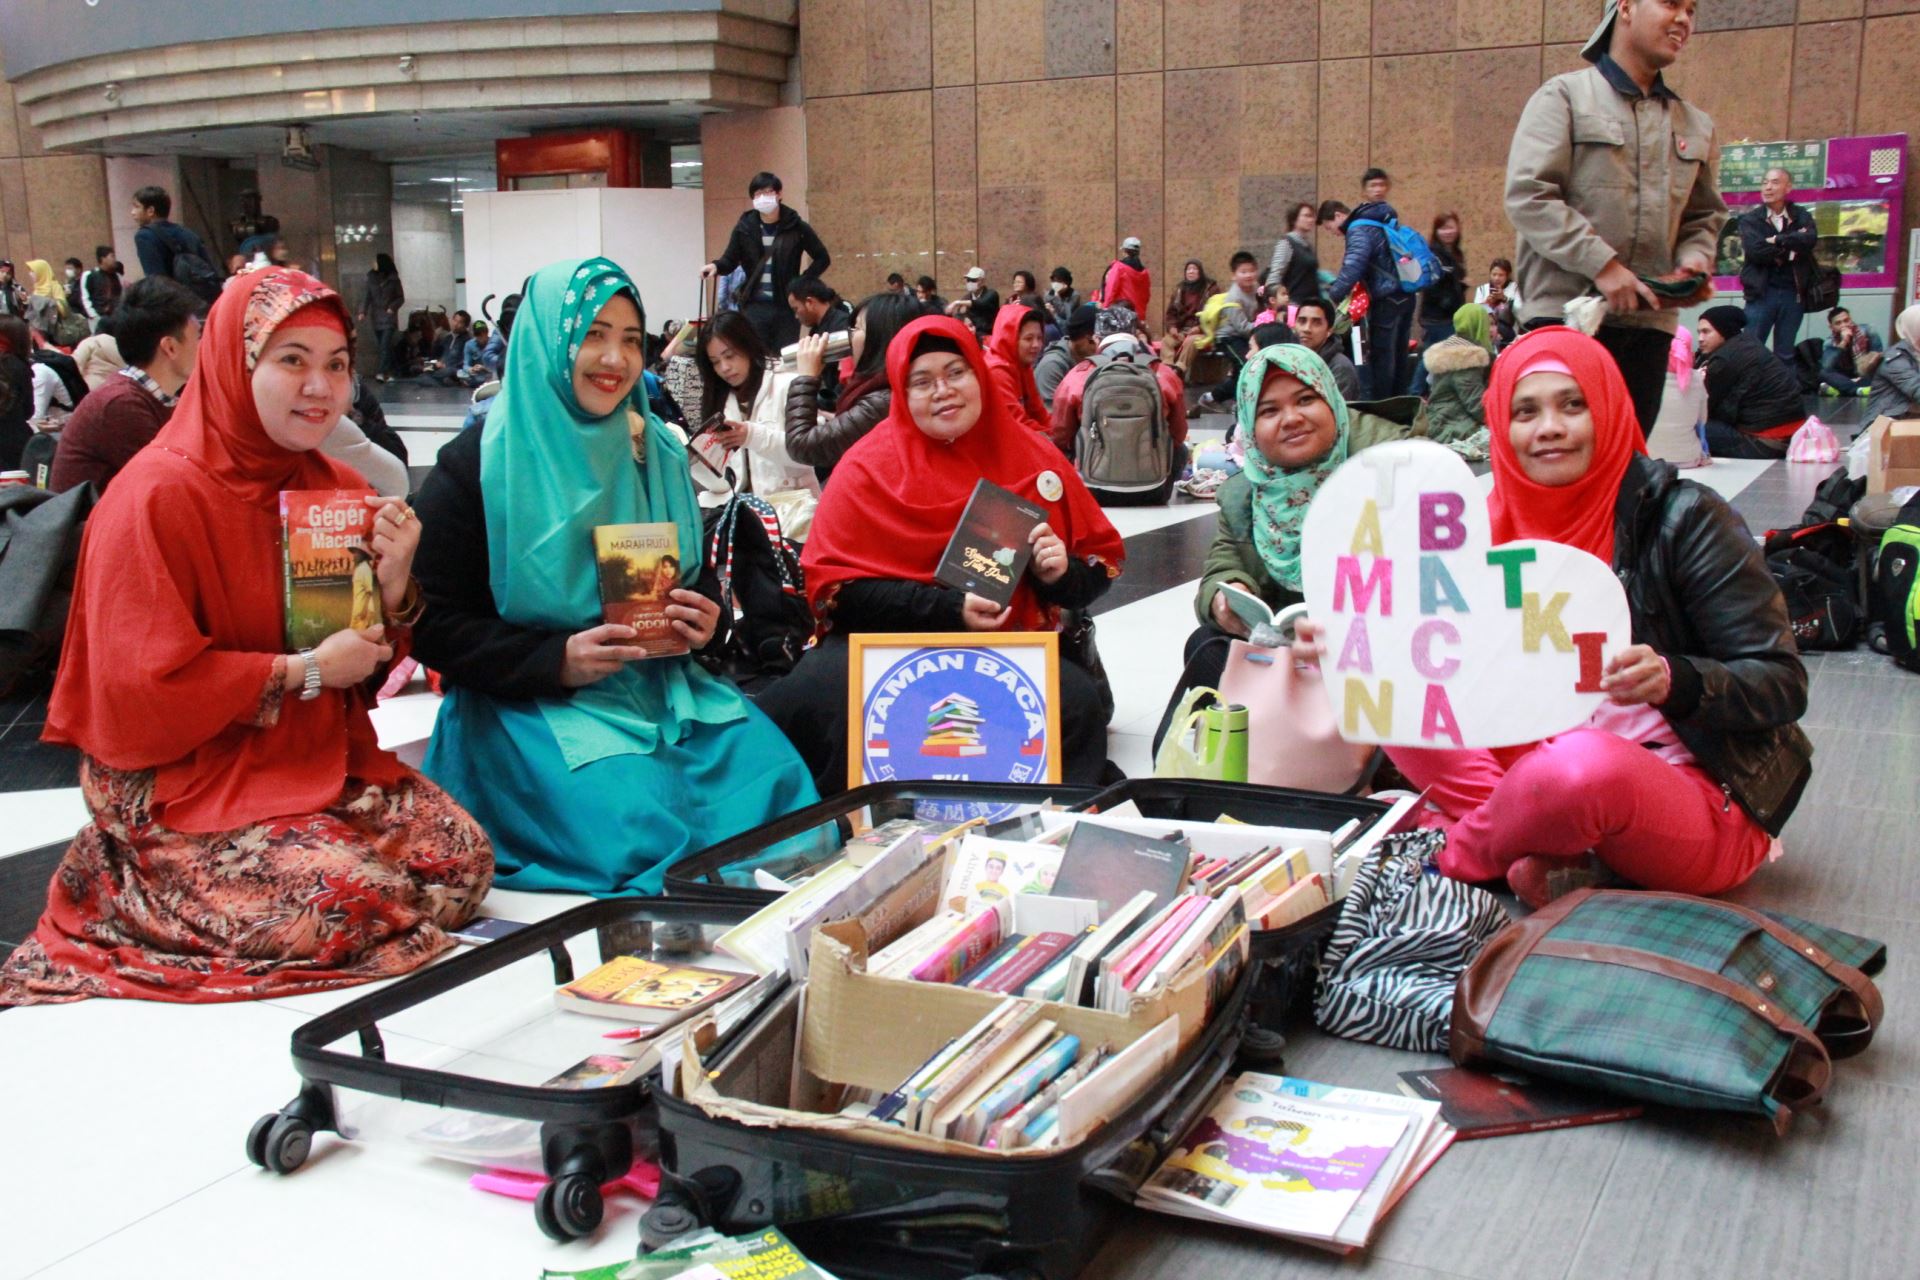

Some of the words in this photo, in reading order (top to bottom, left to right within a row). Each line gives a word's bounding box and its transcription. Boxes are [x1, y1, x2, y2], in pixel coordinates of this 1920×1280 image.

[312, 534, 361, 549] Macan
[1333, 451, 1411, 737] TAMAN
[1411, 492, 1470, 746] BACA
[1487, 548, 1608, 693] TKI
[867, 654, 964, 741] TAMAN
[974, 656, 1044, 739] BACA
